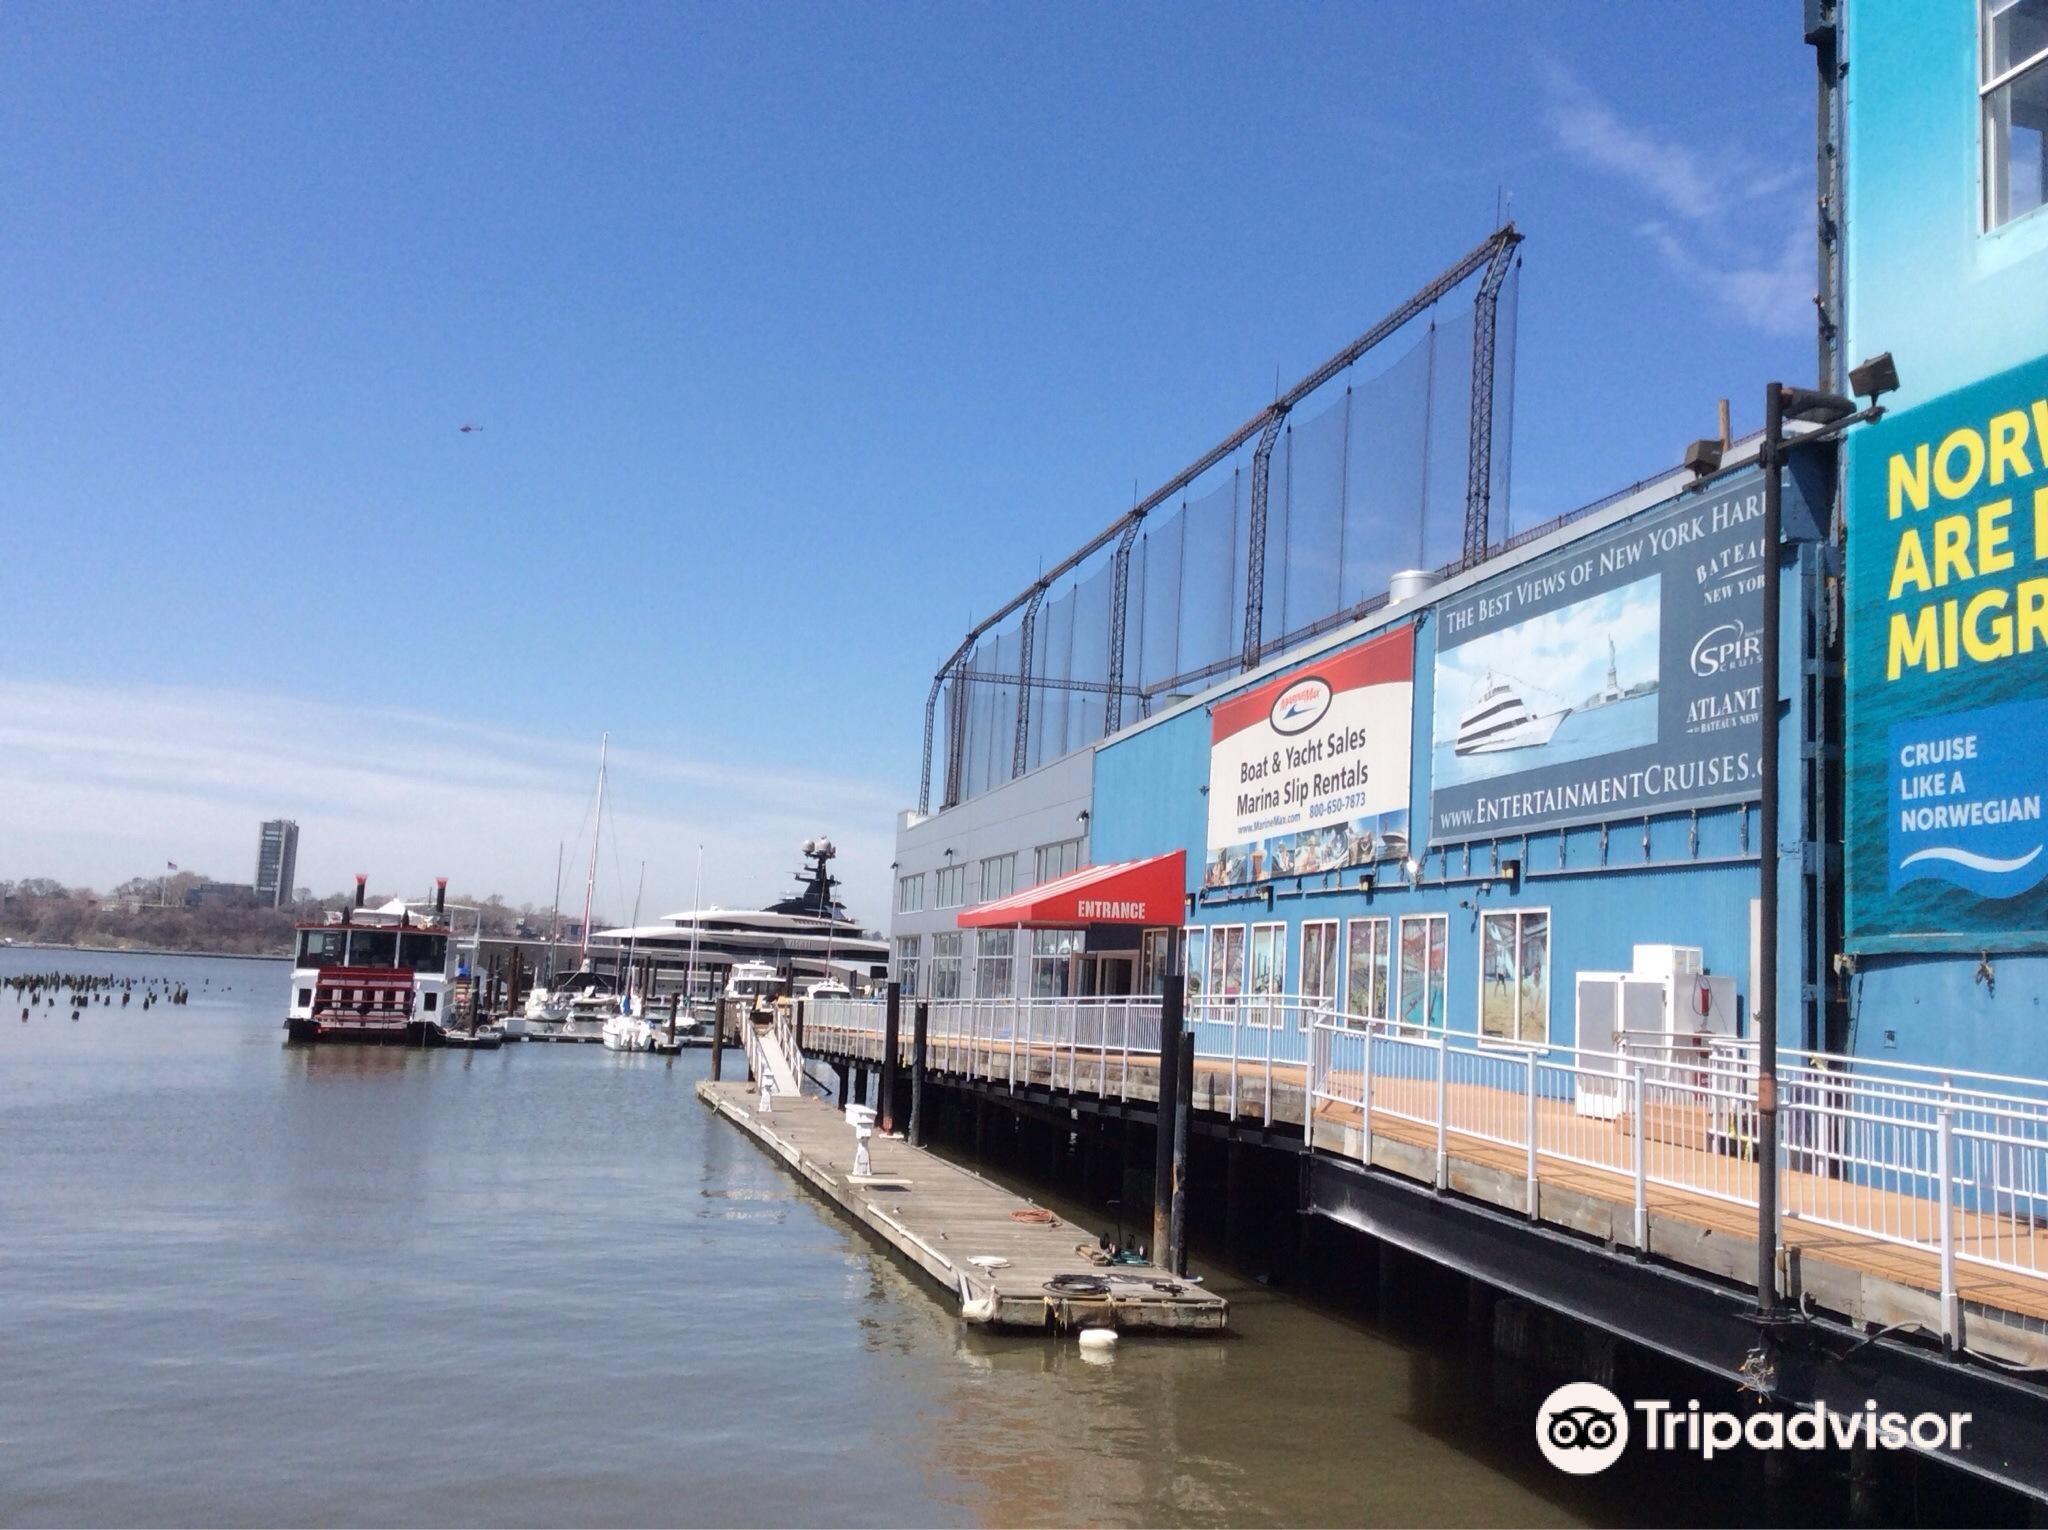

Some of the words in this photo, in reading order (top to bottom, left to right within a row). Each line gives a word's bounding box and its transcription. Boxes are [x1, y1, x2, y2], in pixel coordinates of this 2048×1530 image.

[1888, 498, 2015, 601] ARE
[1446, 608, 1474, 634] THE
[1479, 591, 1513, 623] BEST
[1517, 570, 1566, 606] VIEWS
[1570, 560, 1594, 586] OF
[1600, 539, 1644, 576] NEW
[1648, 516, 1706, 557] YORK
[1703, 584, 1733, 606] NEW
[1887, 577, 2048, 682] MIGR
[1685, 685, 1763, 723] ATLANT
[1240, 756, 1269, 784] Boat
[1271, 750, 1282, 775] &
[1286, 738, 1323, 770] Yacht
[1327, 726, 1367, 759] Sales
[1900, 735, 1978, 768] CRUISE
[1236, 787, 1280, 817] Marina
[1284, 777, 1309, 808] Slip
[1313, 759, 1369, 797] Rentals
[1901, 773, 1947, 801] LIKE
[1950, 770, 1967, 794] A
[1237, 812, 1302, 834] www.MarineMax.com
[1309, 791, 1367, 819] 800-650-7873
[1901, 795, 2041, 833] NORWEGIAN
[1078, 900, 1146, 920] ENTRANCE
